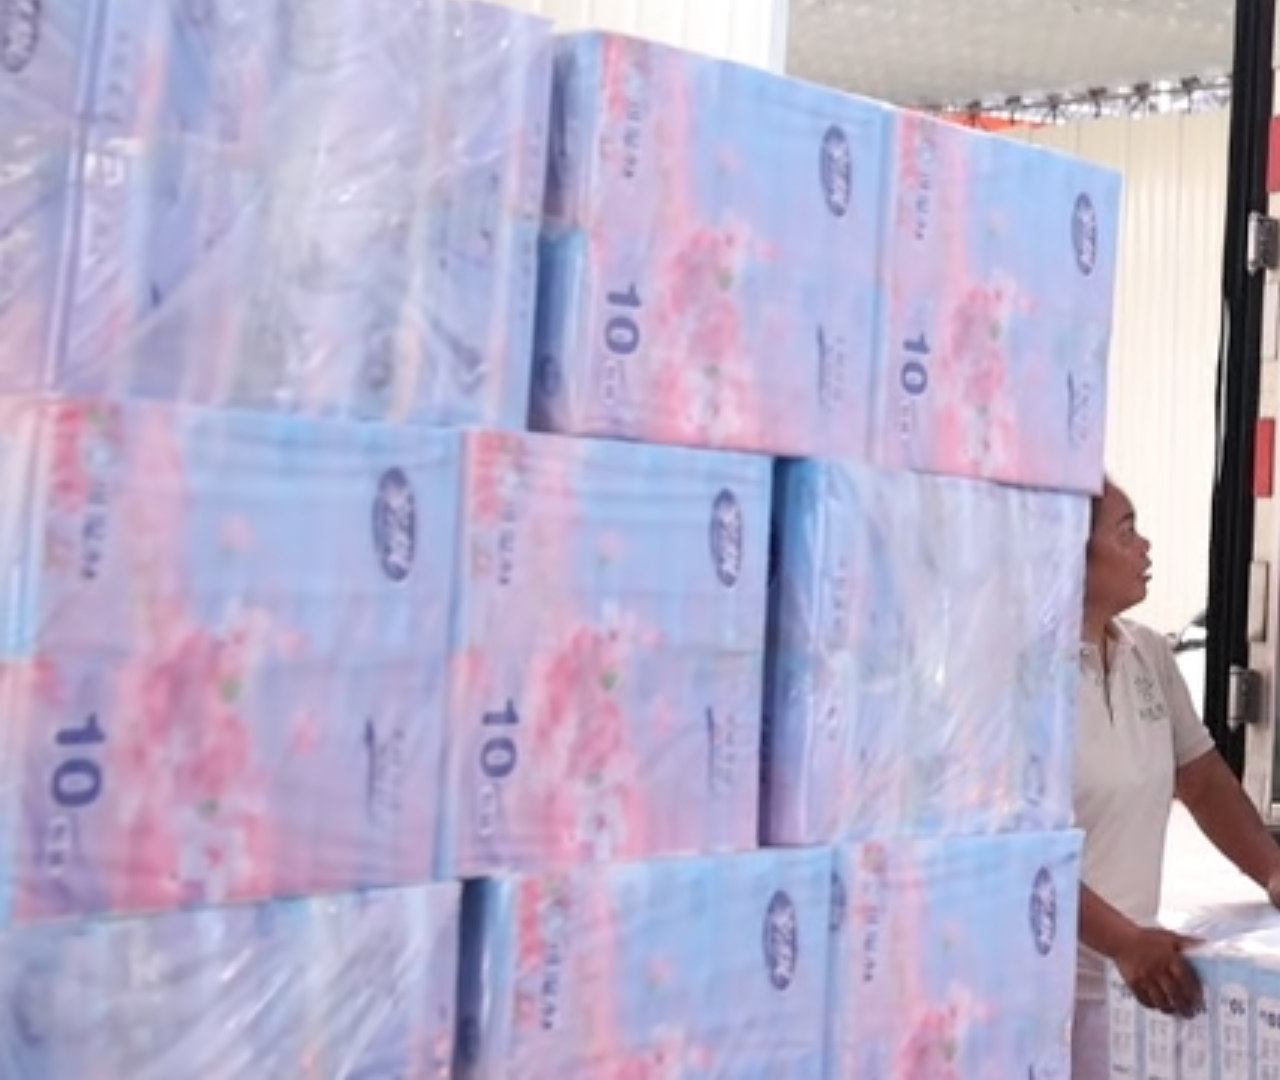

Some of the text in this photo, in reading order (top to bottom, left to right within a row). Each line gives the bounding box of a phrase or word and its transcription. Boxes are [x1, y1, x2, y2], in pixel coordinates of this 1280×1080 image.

[603, 281, 643, 356] 10
[901, 331, 932, 397] 10
[50, 711, 106, 808] 10
[480, 697, 519, 778] 10
